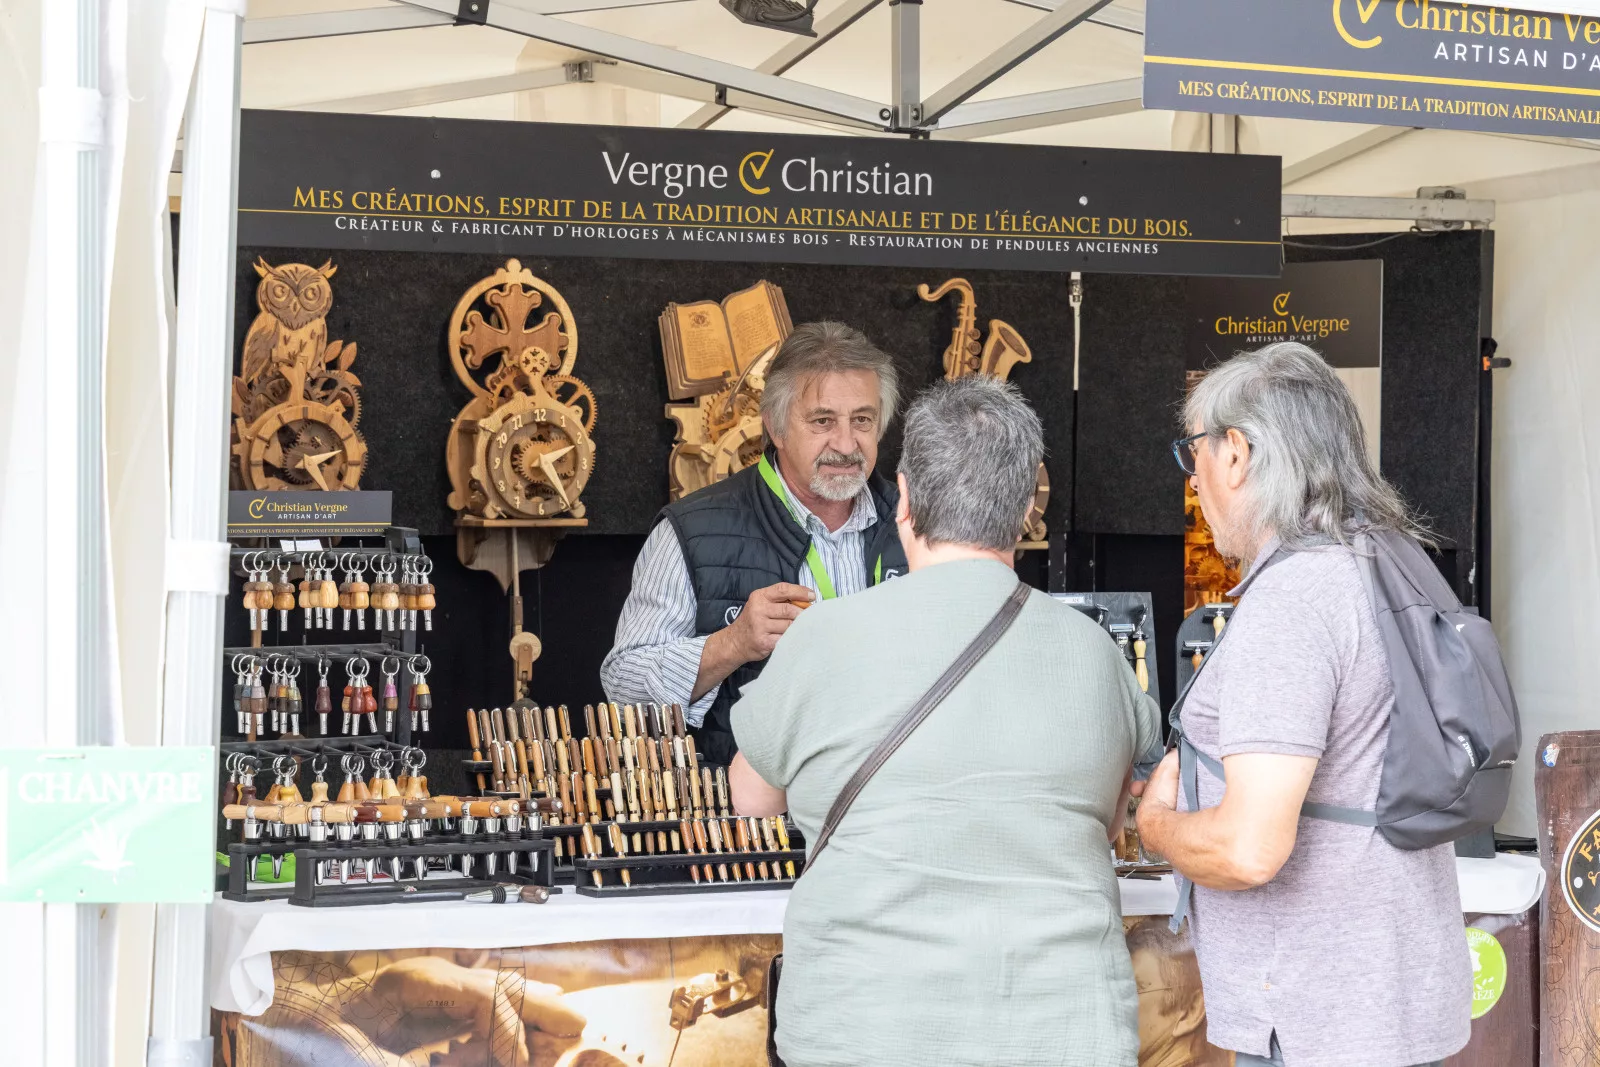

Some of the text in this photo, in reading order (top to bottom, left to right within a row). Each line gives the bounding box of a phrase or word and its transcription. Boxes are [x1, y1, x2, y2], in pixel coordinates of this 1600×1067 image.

[1396, 0, 1600, 45] Christian Ve
[1434, 41, 1600, 72] ARTISAN D'A
[1179, 80, 1213, 97] MES
[1217, 81, 1314, 105] CRÉATIONS,
[1318, 91, 1373, 108] ESPRIT
[1377, 95, 1398, 110] DE
[1401, 98, 1421, 112] LA
[1424, 98, 1509, 118] TRADITION
[602, 151, 933, 199] Vergne Christian
[293, 187, 1194, 237] MES CRÉATIONS, ESPRIT DE LA TRADITION ARTISANALE ET DE L'ÉLÉGANCE DU BOIS.
[334, 216, 424, 233] CRÉATEUR
[431, 219, 444, 233] &
[452, 221, 545, 237] FABRICANT
[553, 223, 659, 241] D'HORLOGES
[666, 226, 676, 241] À
[682, 228, 785, 244] MÉCANISMES
[793, 233, 828, 245] BOIS
[849, 233, 963, 250] RESTAURATION
[971, 238, 989, 250] DE
[996, 239, 1070, 252] PENDULES
[1075, 242, 1158, 254] ANCIENNES
[1214, 315, 1350, 338] Christian Vergne
[1246, 335, 1285, 343] ARTISAN
[534, 409, 547, 422] 12
[560, 415, 566, 428] 1
[577, 432, 583, 445] 2
[493, 457, 501, 470] 9
[581, 457, 588, 470] 3
[498, 480, 506, 492] 8
[266, 502, 348, 514] Christian Vergne
[513, 497, 521, 509] 7
[538, 503, 545, 516] 6
[18, 771, 202, 803] CHANVRE
